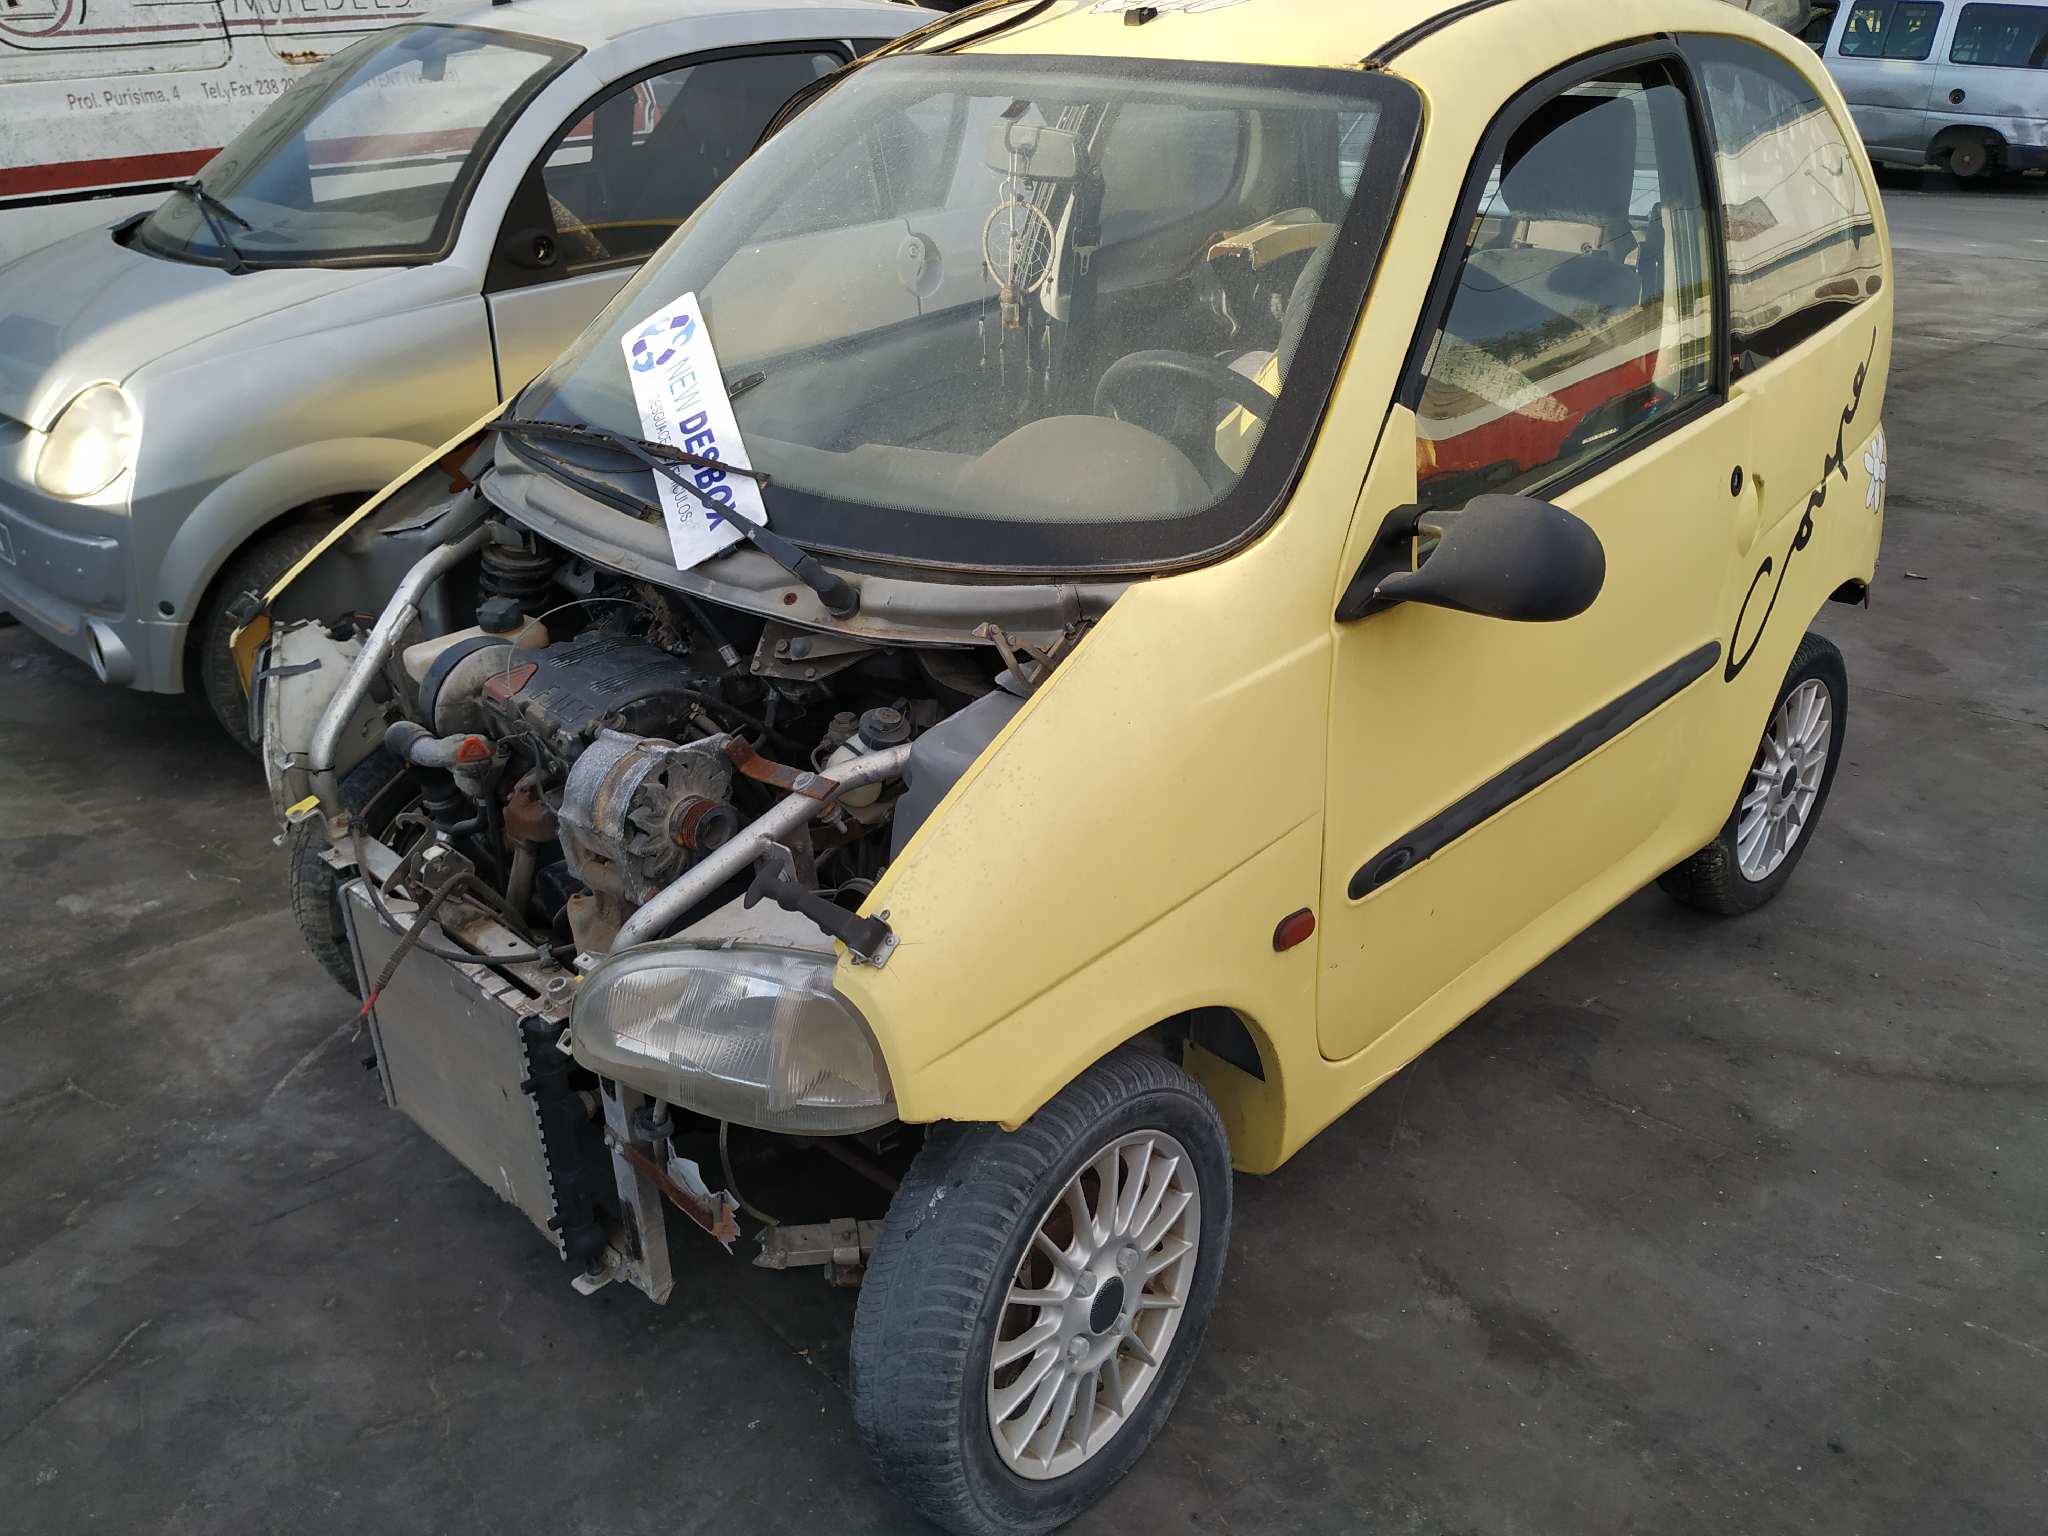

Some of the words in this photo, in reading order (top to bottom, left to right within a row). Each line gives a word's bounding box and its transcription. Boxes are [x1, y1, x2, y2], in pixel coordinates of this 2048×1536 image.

[66, 92, 102, 110] Prol.
[173, 85, 181, 101] 4
[256, 79, 280, 96] 238
[666, 356, 702, 412] NEW
[1724, 325, 1877, 683] Coupe
